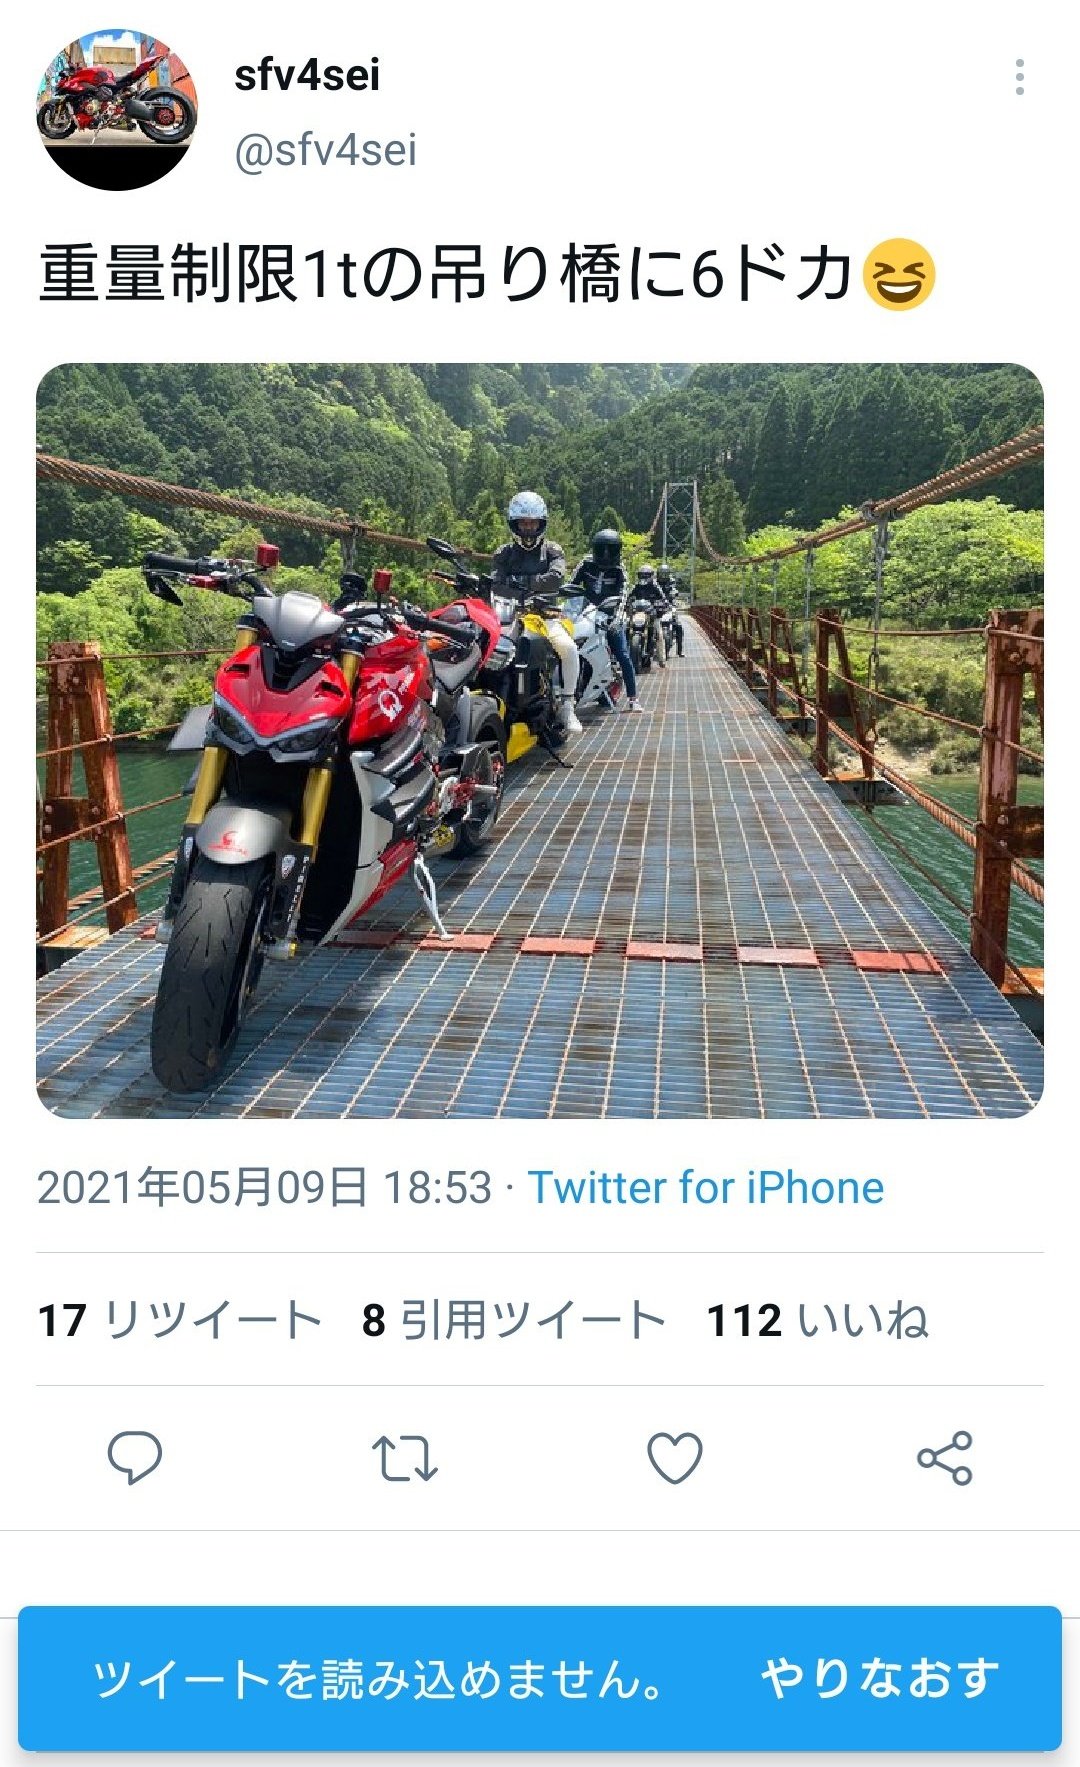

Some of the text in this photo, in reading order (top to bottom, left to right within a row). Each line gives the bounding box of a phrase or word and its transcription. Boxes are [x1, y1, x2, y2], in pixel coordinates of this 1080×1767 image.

[235, 56, 379, 91] sfv4sei
[236, 131, 416, 175] @sfv4sei
[39, 242, 850, 304] 重量制限1tの吊り橋に6ドカ
[38, 1166, 492, 1207] 2021年05月09日 18:53
[528, 1167, 885, 1206] Twitter for iPhone
[38, 1299, 321, 1340] 17 リツイート
[362, 1298, 665, 1341] 8 引用ツイート
[707, 1299, 930, 1340] 112 いいね
[95, 1657, 659, 1702] ツイートを読み込めません。
[761, 1655, 1000, 1701] やりなおす
